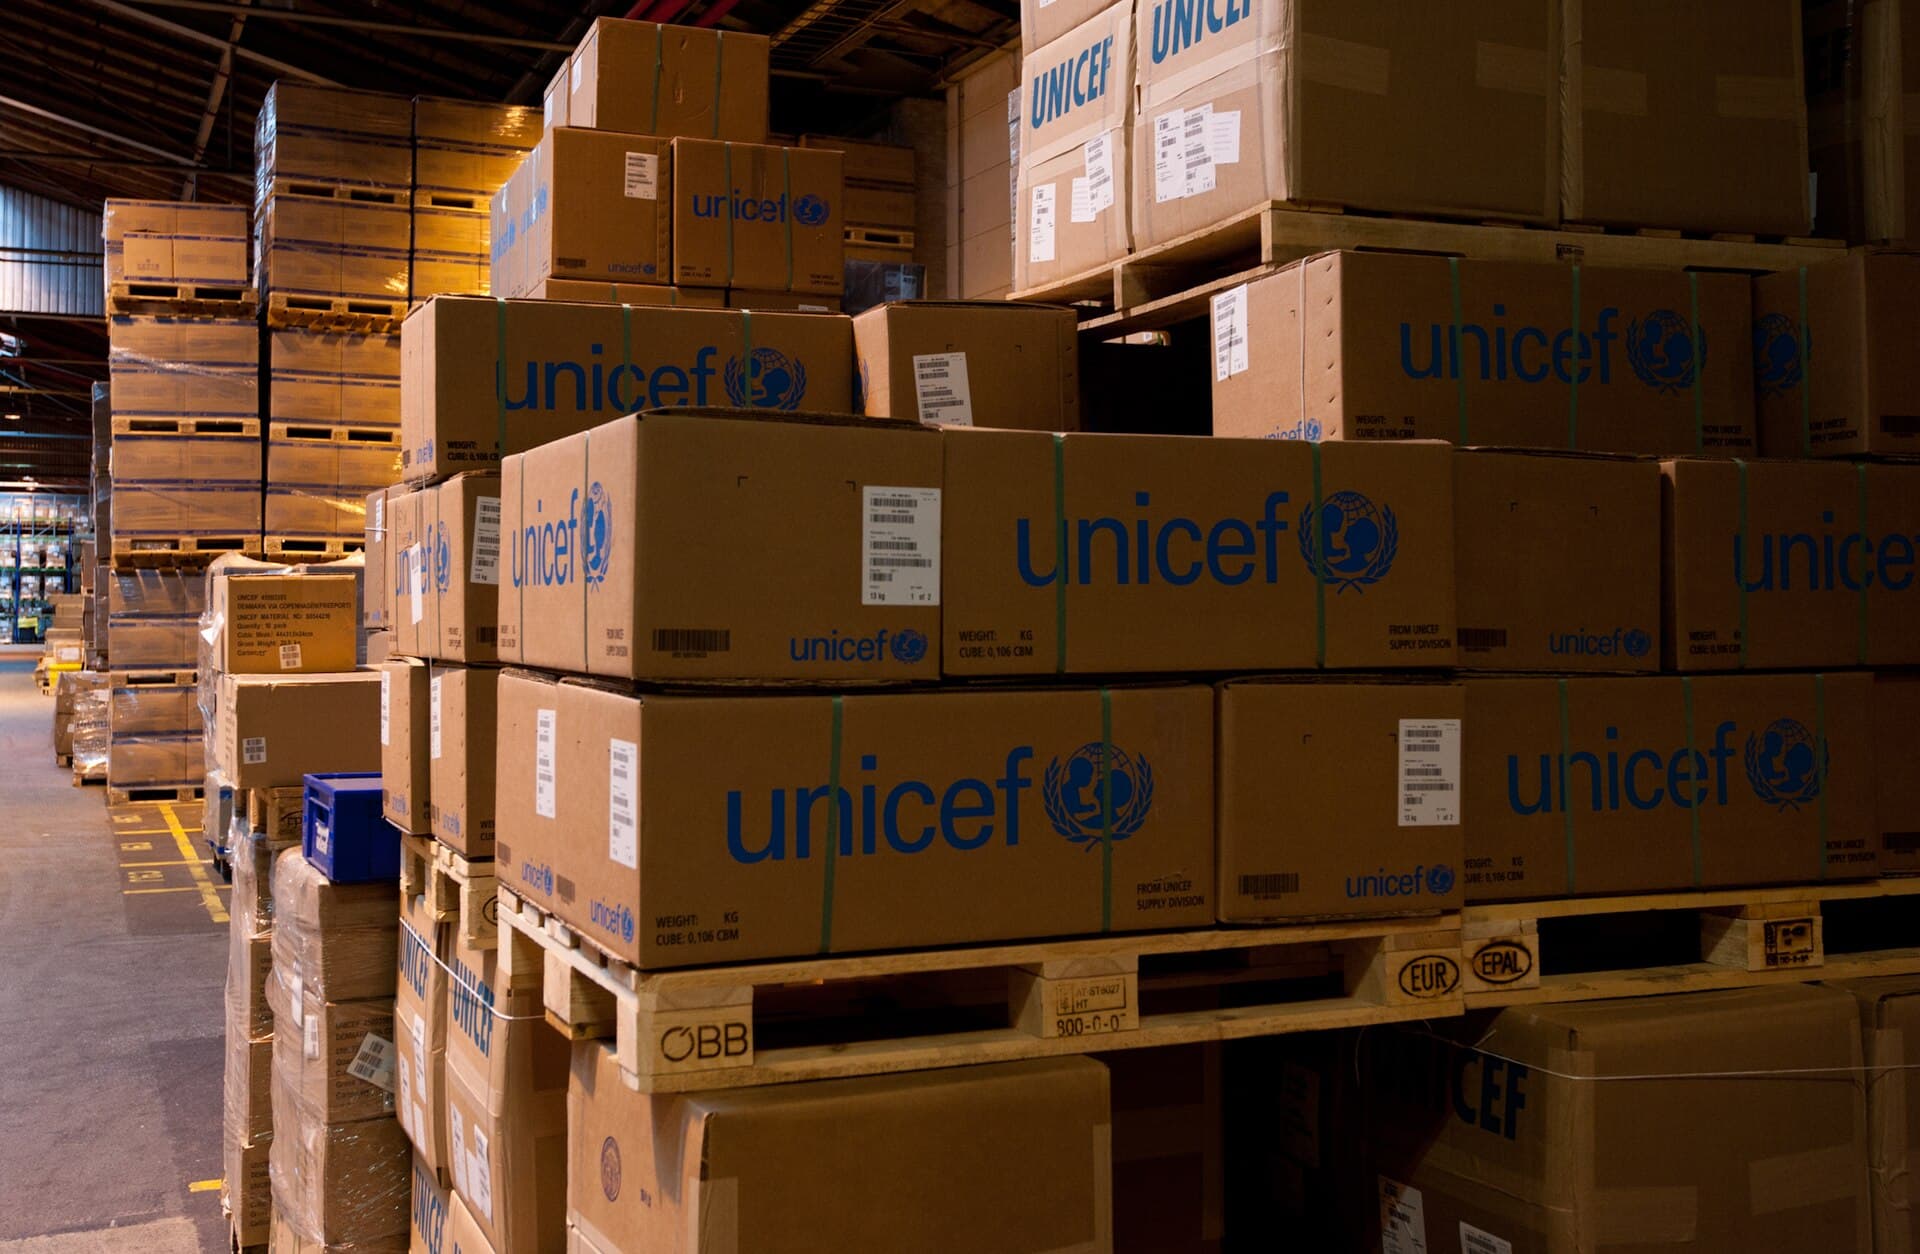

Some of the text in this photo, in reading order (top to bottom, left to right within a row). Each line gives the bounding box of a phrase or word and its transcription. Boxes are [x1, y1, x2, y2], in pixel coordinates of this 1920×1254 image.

[1031, 34, 1114, 129] UNICEF
[692, 190, 787, 223] unicef
[1400, 304, 1618, 384] unicef
[496, 343, 717, 413] unicef
[512, 487, 578, 588] unicef
[1016, 491, 1289, 587] unicef
[1733, 510, 1920, 592] unice
[789, 629, 888, 662] unicef
[958, 629, 1033, 642] WEIGHT: KG
[1388, 624, 1440, 636] FROM UNICEF
[1389, 638, 1451, 650] SUPPLY DIVISION
[1548, 627, 1622, 656] unicef
[958, 646, 985, 658] CUBE:
[1013, 645, 1033, 657] CBM
[1506, 722, 1737, 816] unicef
[726, 745, 1034, 864] unicef
[522, 858, 545, 890] unicef
[1136, 880, 1192, 894] FROM UNICEF
[1346, 865, 1424, 898] unicef
[590, 897, 622, 936] unicef
[655, 911, 739, 928] WEIGHT: KG
[1136, 895, 1205, 911] SUPPLY DIVISION
[655, 932, 686, 946] CUBE:
[716, 928, 739, 942] CBM
[400, 916, 430, 1002] UNICEF
[1481, 950, 1523, 975] EPAL
[1411, 962, 1447, 992] EUR
[454, 957, 495, 1058] UNICEF
[1076, 998, 1088, 1009] HT
